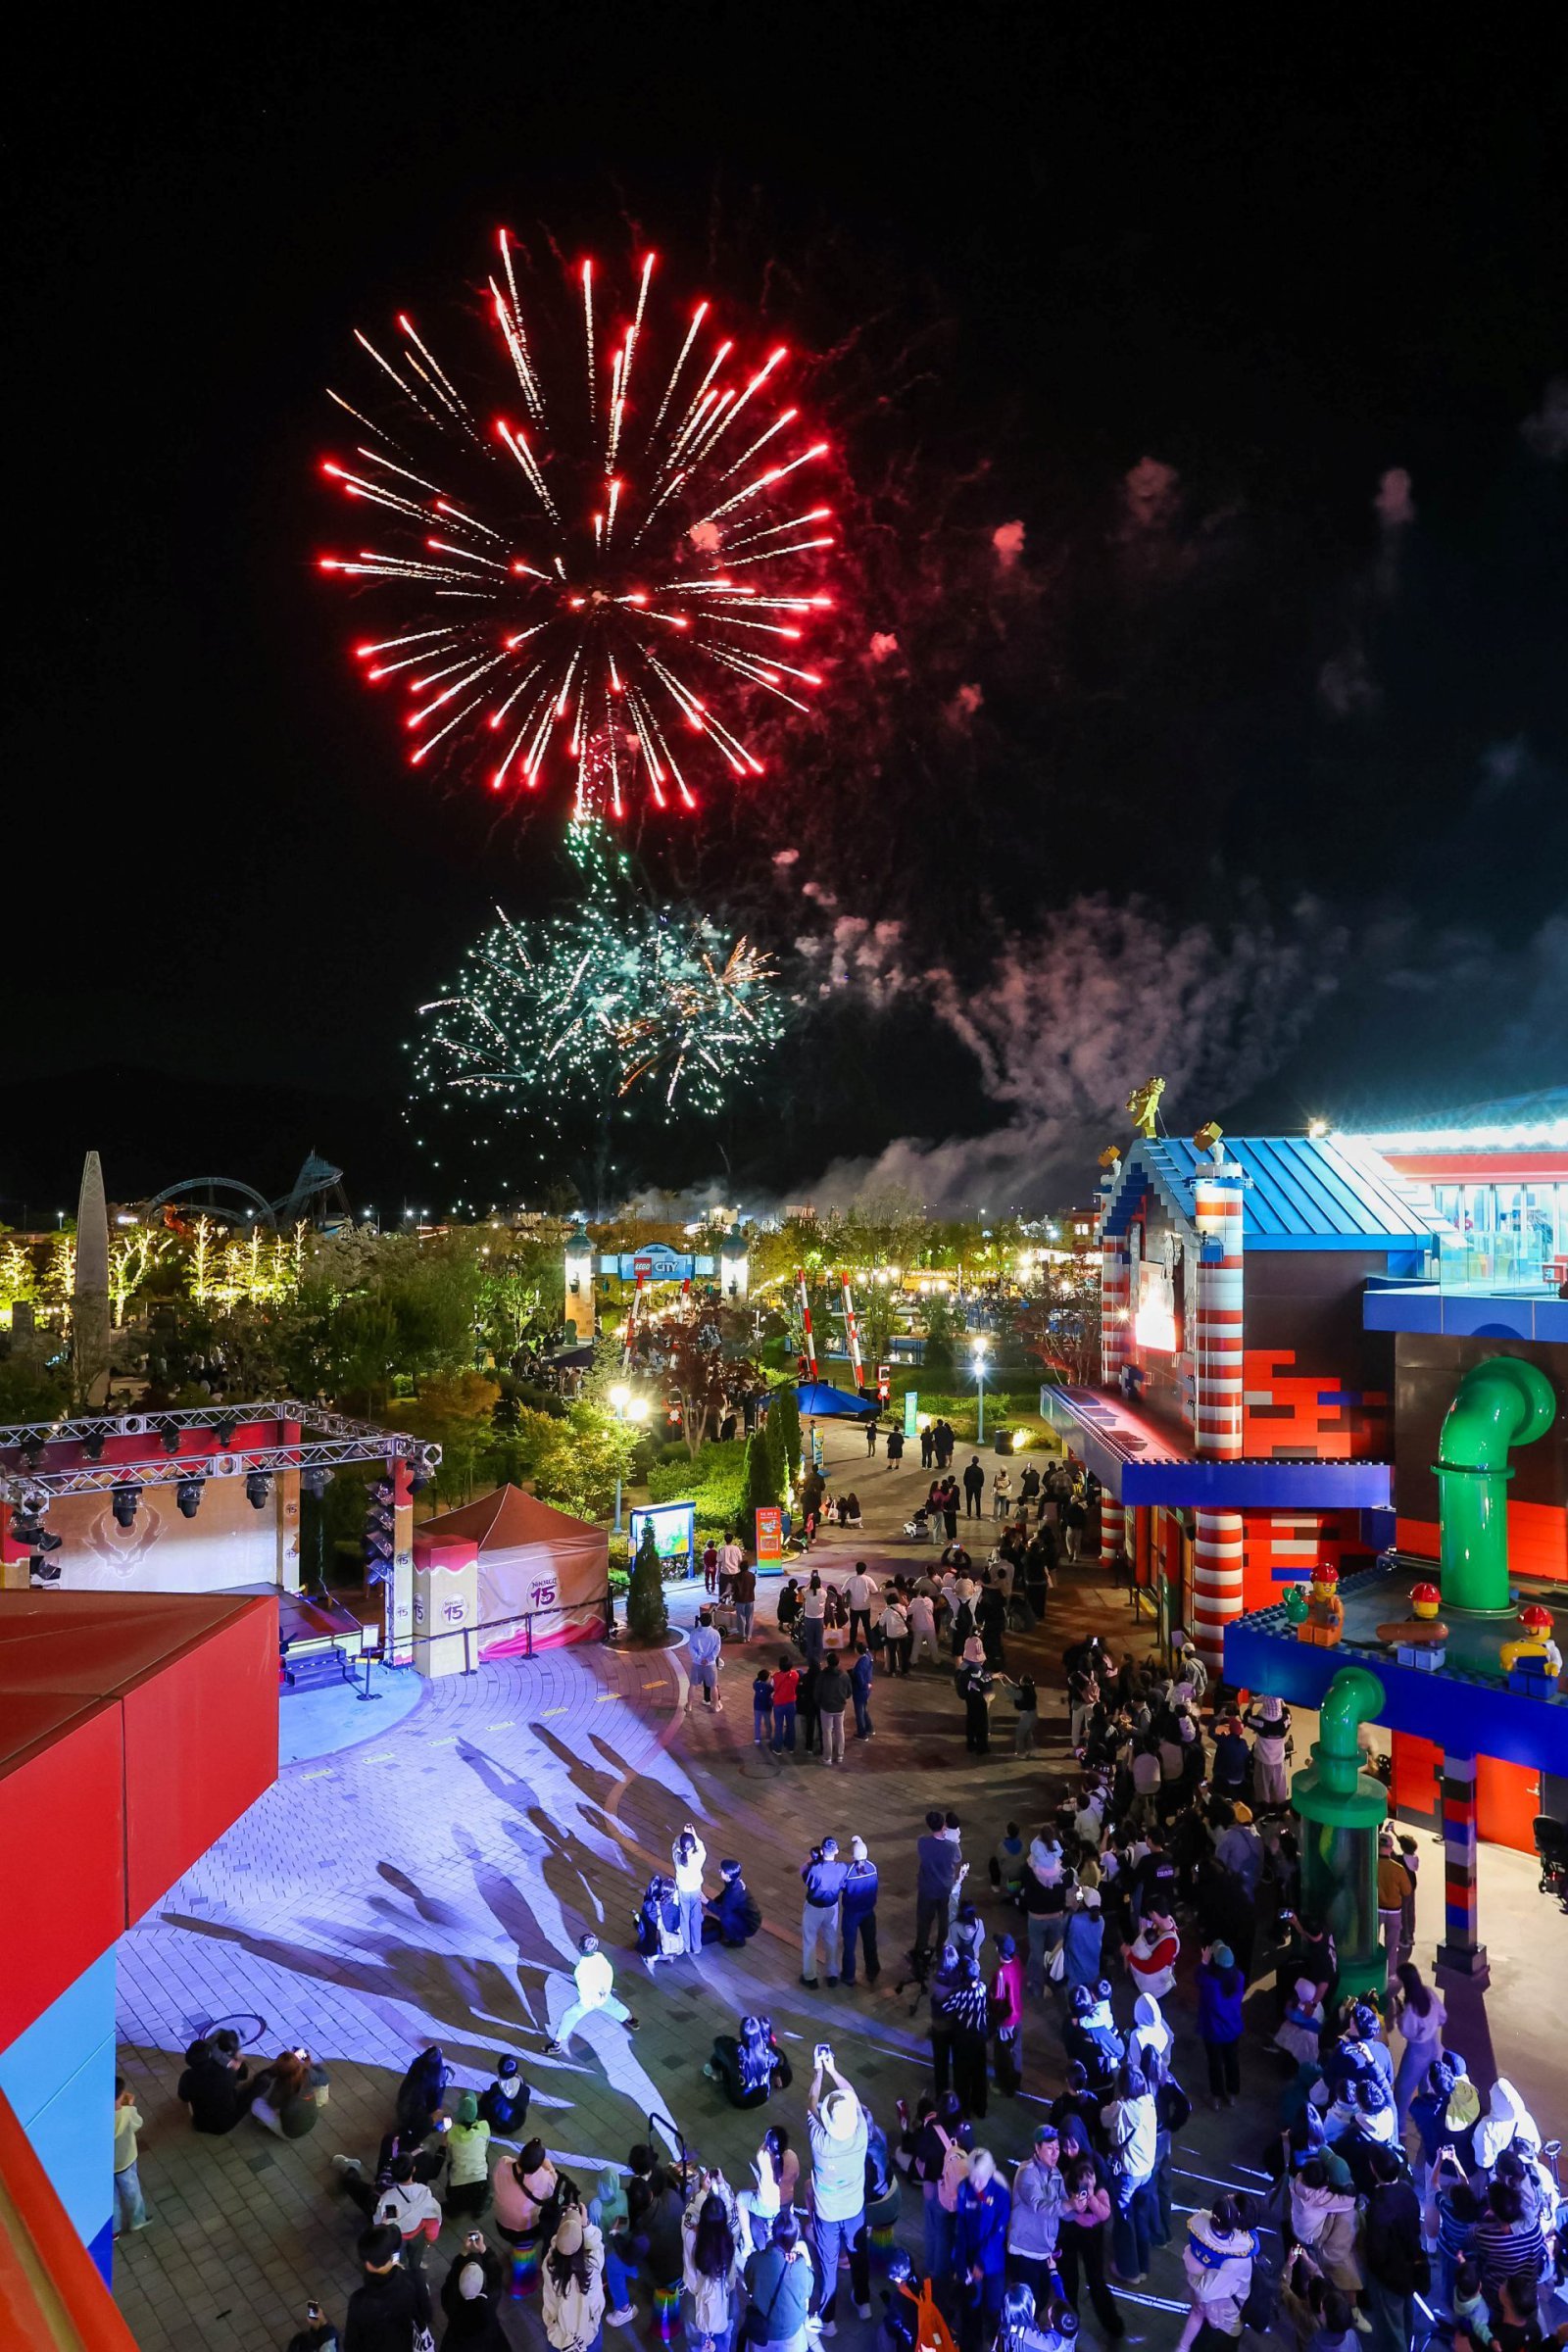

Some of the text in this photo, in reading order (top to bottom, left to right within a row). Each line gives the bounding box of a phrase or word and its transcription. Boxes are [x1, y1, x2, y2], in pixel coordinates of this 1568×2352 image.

[655, 1261, 678, 1272] CITY
[397, 1556, 409, 1565] 15
[530, 1585, 556, 1608] 15
[444, 1604, 464, 1622] 15
